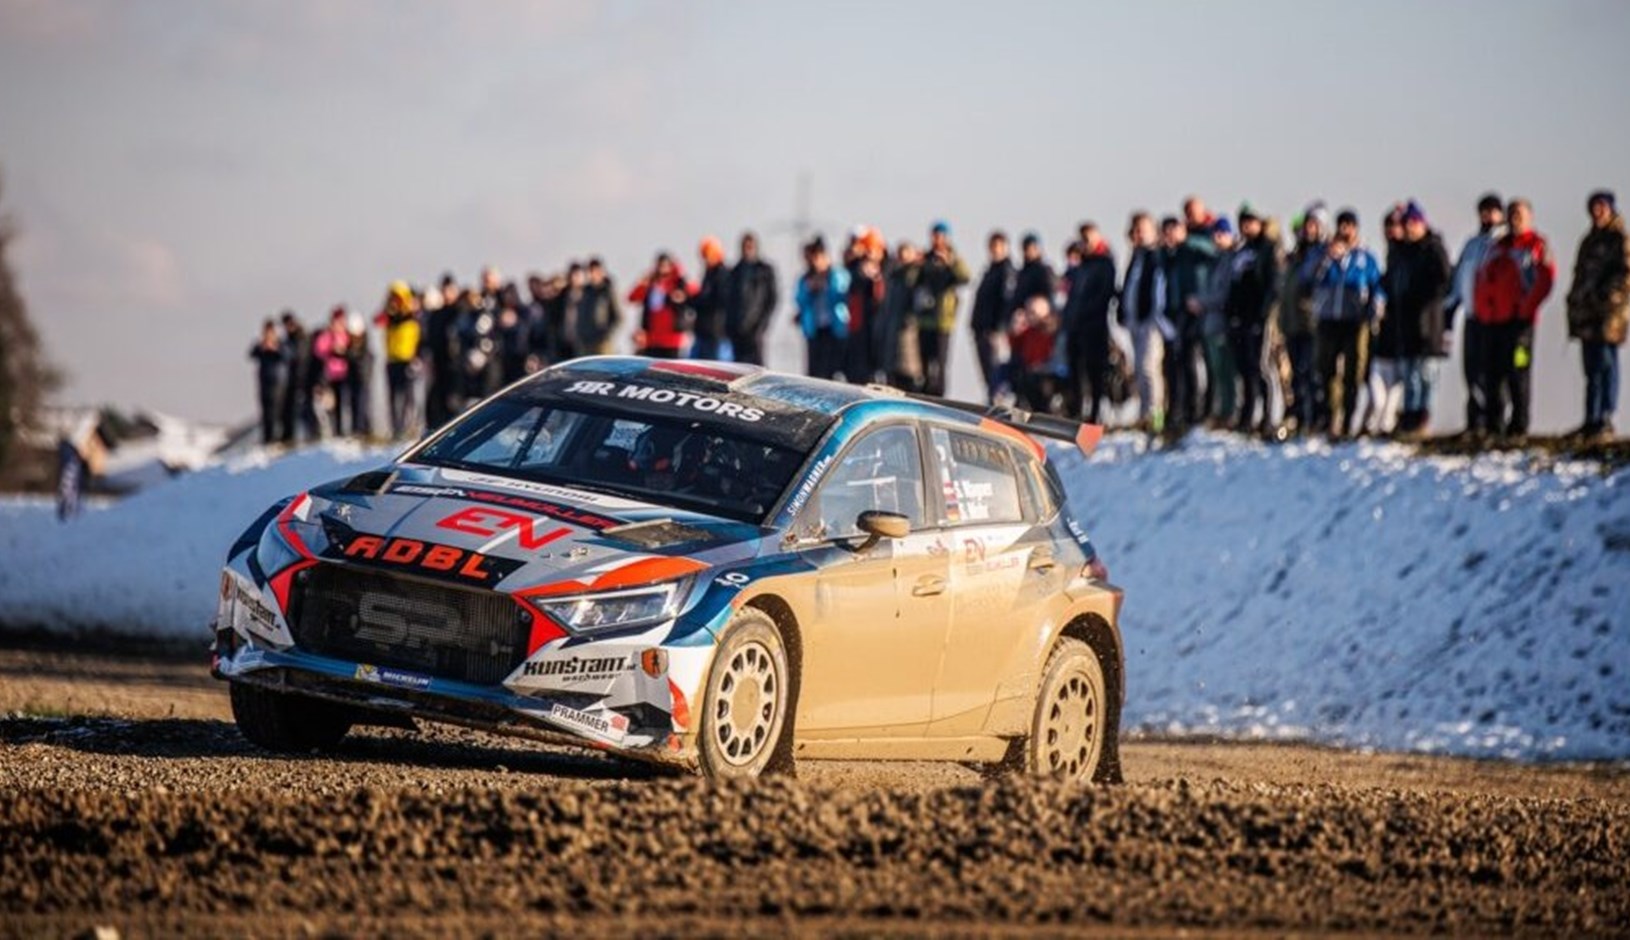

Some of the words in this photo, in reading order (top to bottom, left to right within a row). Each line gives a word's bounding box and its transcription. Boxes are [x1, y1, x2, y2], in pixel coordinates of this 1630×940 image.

[618, 385, 765, 422] MOTORS
[435, 506, 574, 551] EN
[344, 535, 489, 579] ADBL
[383, 670, 430, 686] MICHELIN
[552, 704, 609, 734] PRAMMER
